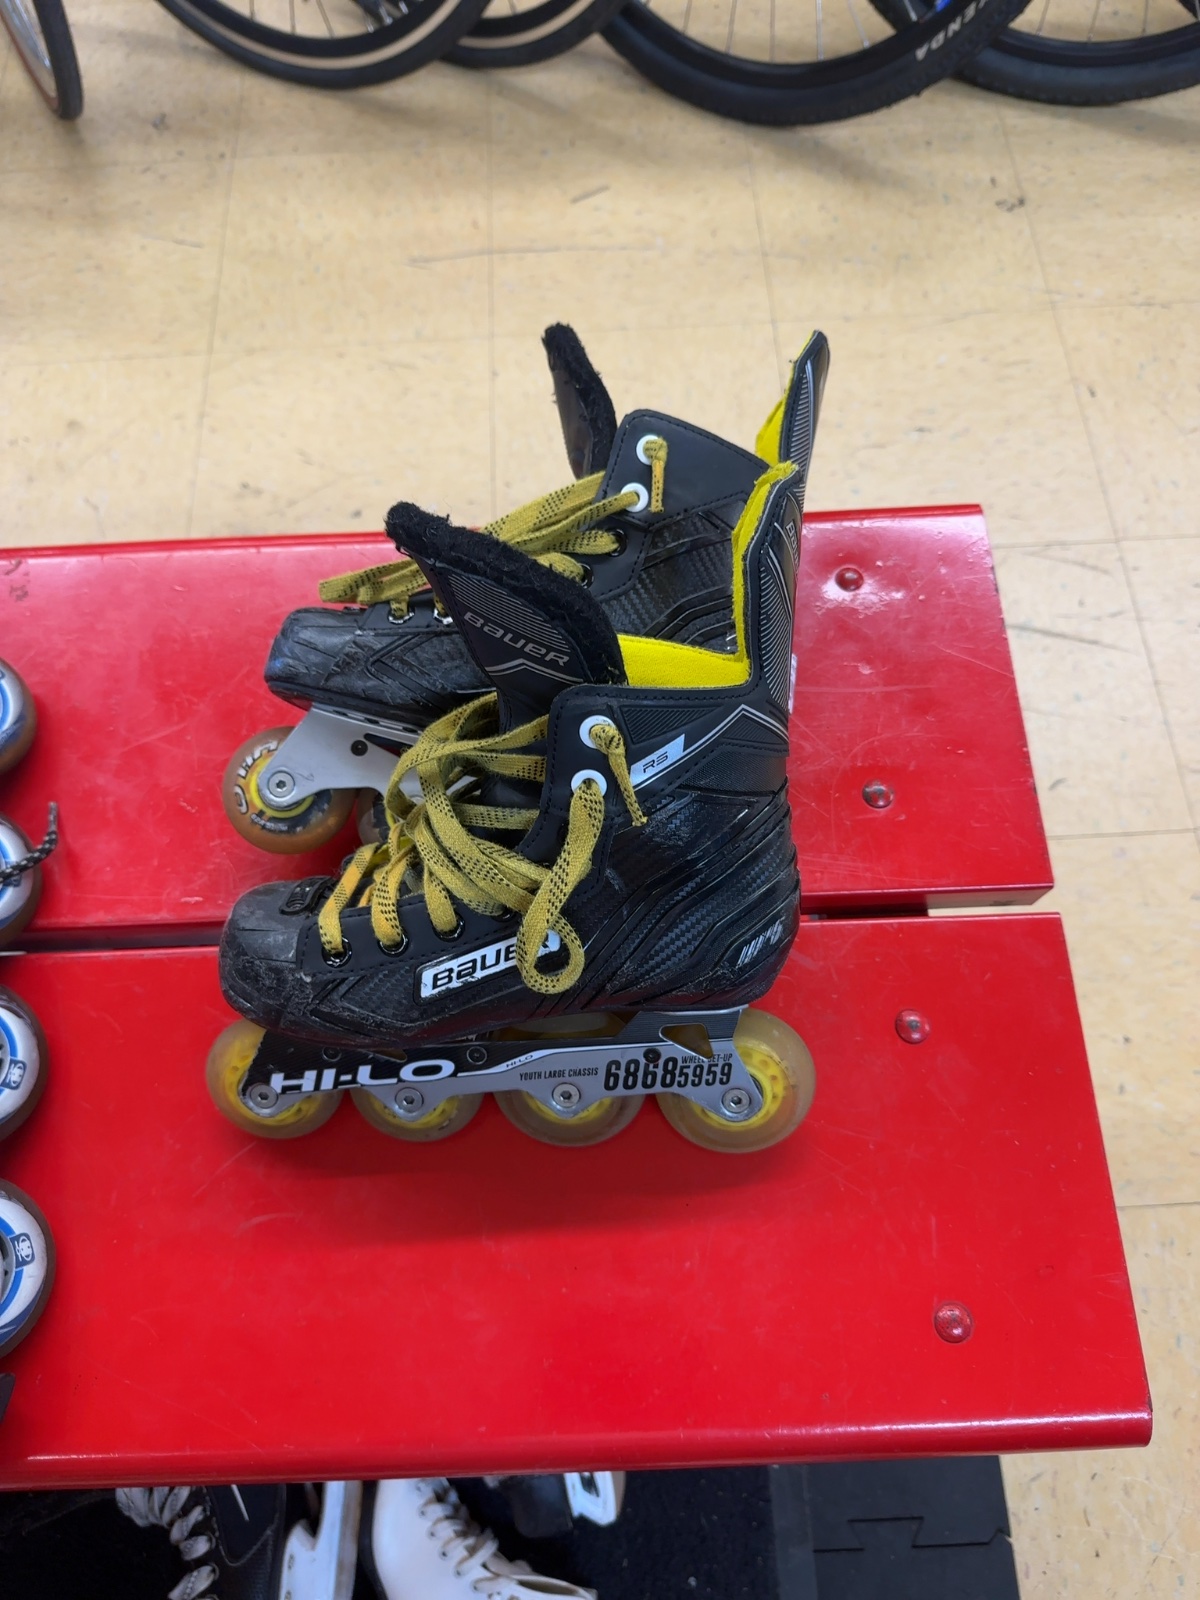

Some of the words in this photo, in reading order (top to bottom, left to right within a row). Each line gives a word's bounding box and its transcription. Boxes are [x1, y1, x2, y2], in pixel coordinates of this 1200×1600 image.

[642, 751, 668, 773] RS
[432, 940, 549, 990] BAUE
[506, 1054, 533, 1068] HI-LO
[269, 1059, 455, 1093] HI-LO
[520, 1071, 543, 1081] YOUTH
[544, 1069, 567, 1079] LARGE
[568, 1067, 599, 1078] CHASSIS
